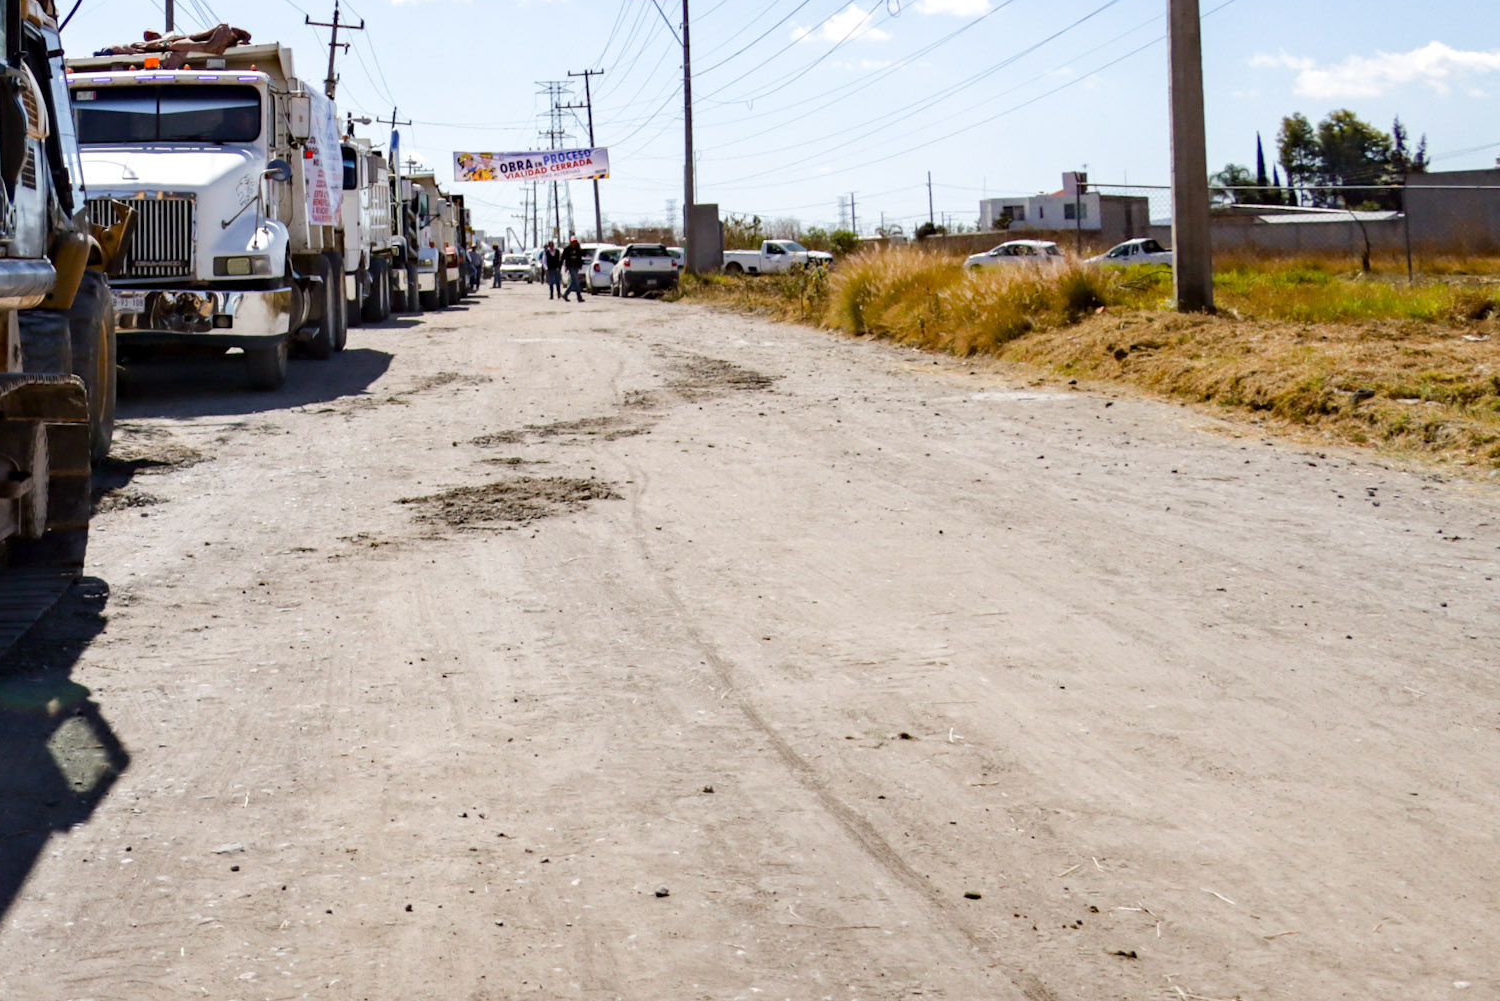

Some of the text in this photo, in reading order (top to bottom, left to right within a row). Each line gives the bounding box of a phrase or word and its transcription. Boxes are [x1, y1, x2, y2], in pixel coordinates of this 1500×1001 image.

[500, 159, 533, 173] OBRA
[543, 150, 591, 164] PROCESO
[504, 168, 547, 179] VIALIDAD
[550, 158, 593, 172] CERRADA
